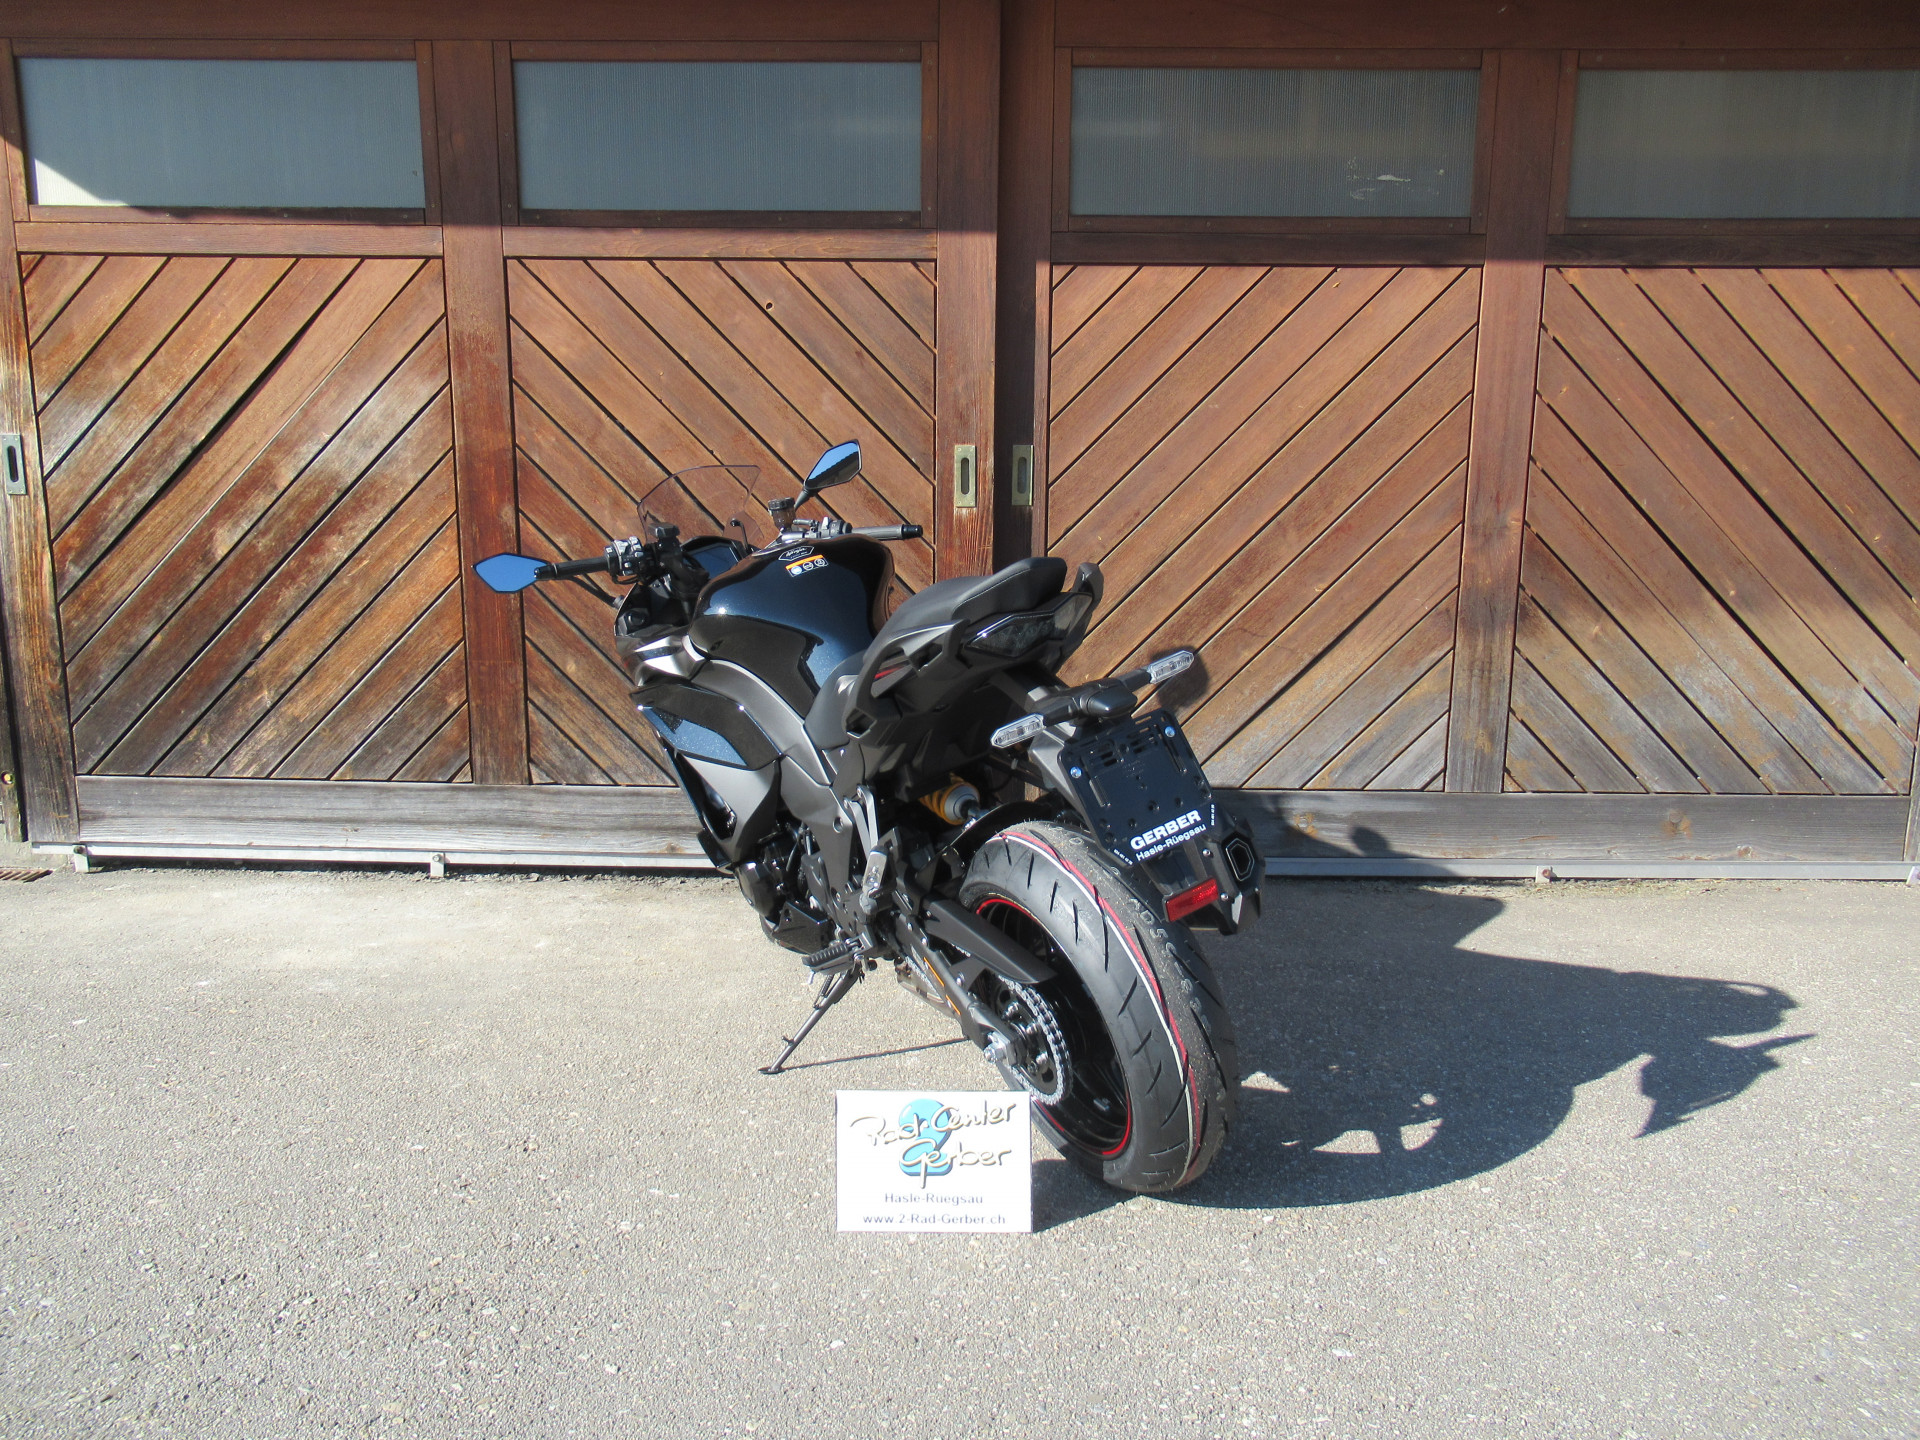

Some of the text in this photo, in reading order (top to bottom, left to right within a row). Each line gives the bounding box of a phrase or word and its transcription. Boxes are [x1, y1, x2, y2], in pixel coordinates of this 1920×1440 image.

[1130, 809, 1202, 851] GERBER
[1135, 823, 1207, 862] Hasle-Rüegsau
[901, 1138, 1013, 1190] Gerber
[863, 1213, 1006, 1225] www.2-Rad-Gerber.ch
